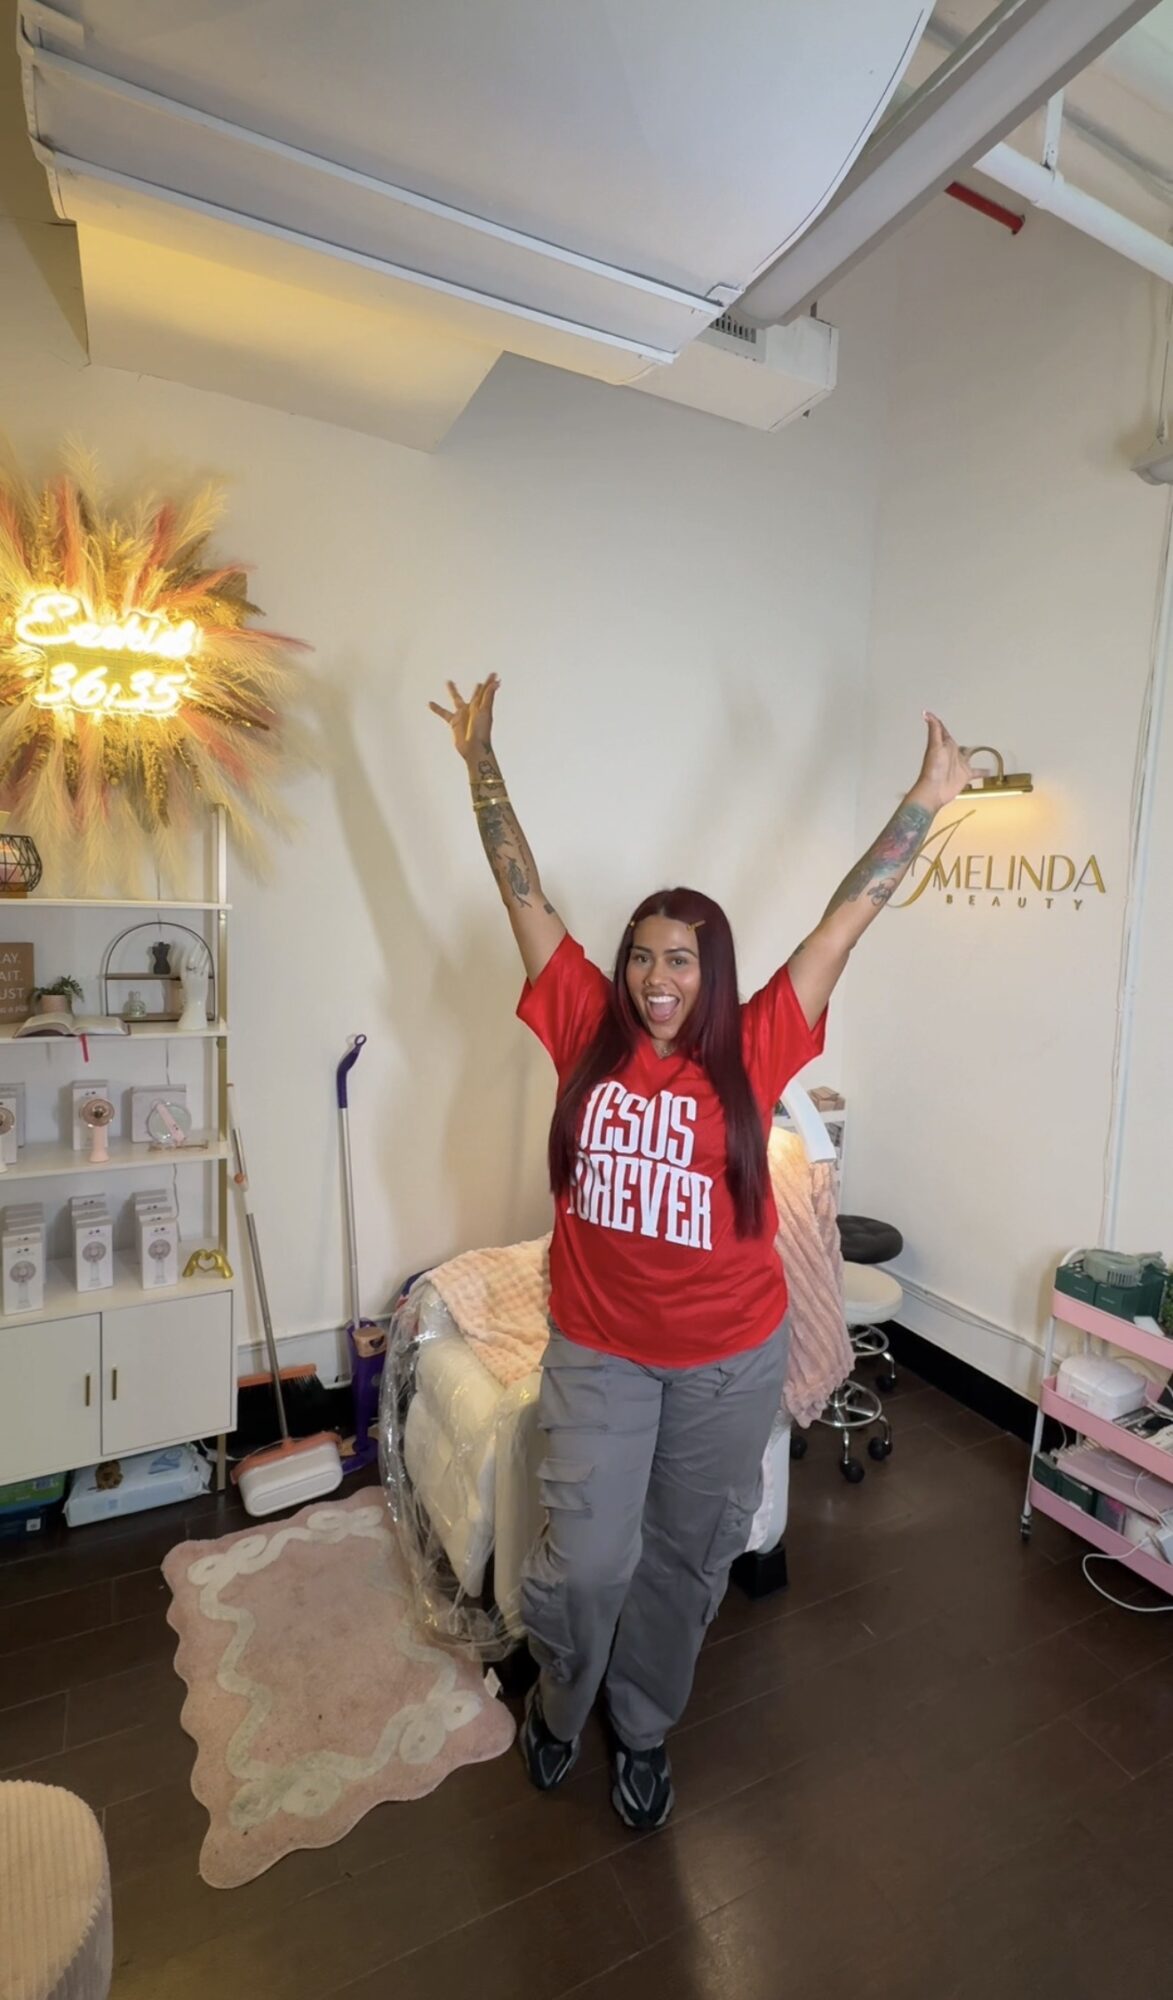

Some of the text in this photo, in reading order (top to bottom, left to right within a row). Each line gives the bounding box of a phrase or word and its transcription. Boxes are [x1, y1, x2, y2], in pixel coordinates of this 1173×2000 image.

[946, 894, 1083, 911] BEAUTY
[0, 952, 22, 964] AY.
[0, 970, 24, 982] AIT.
